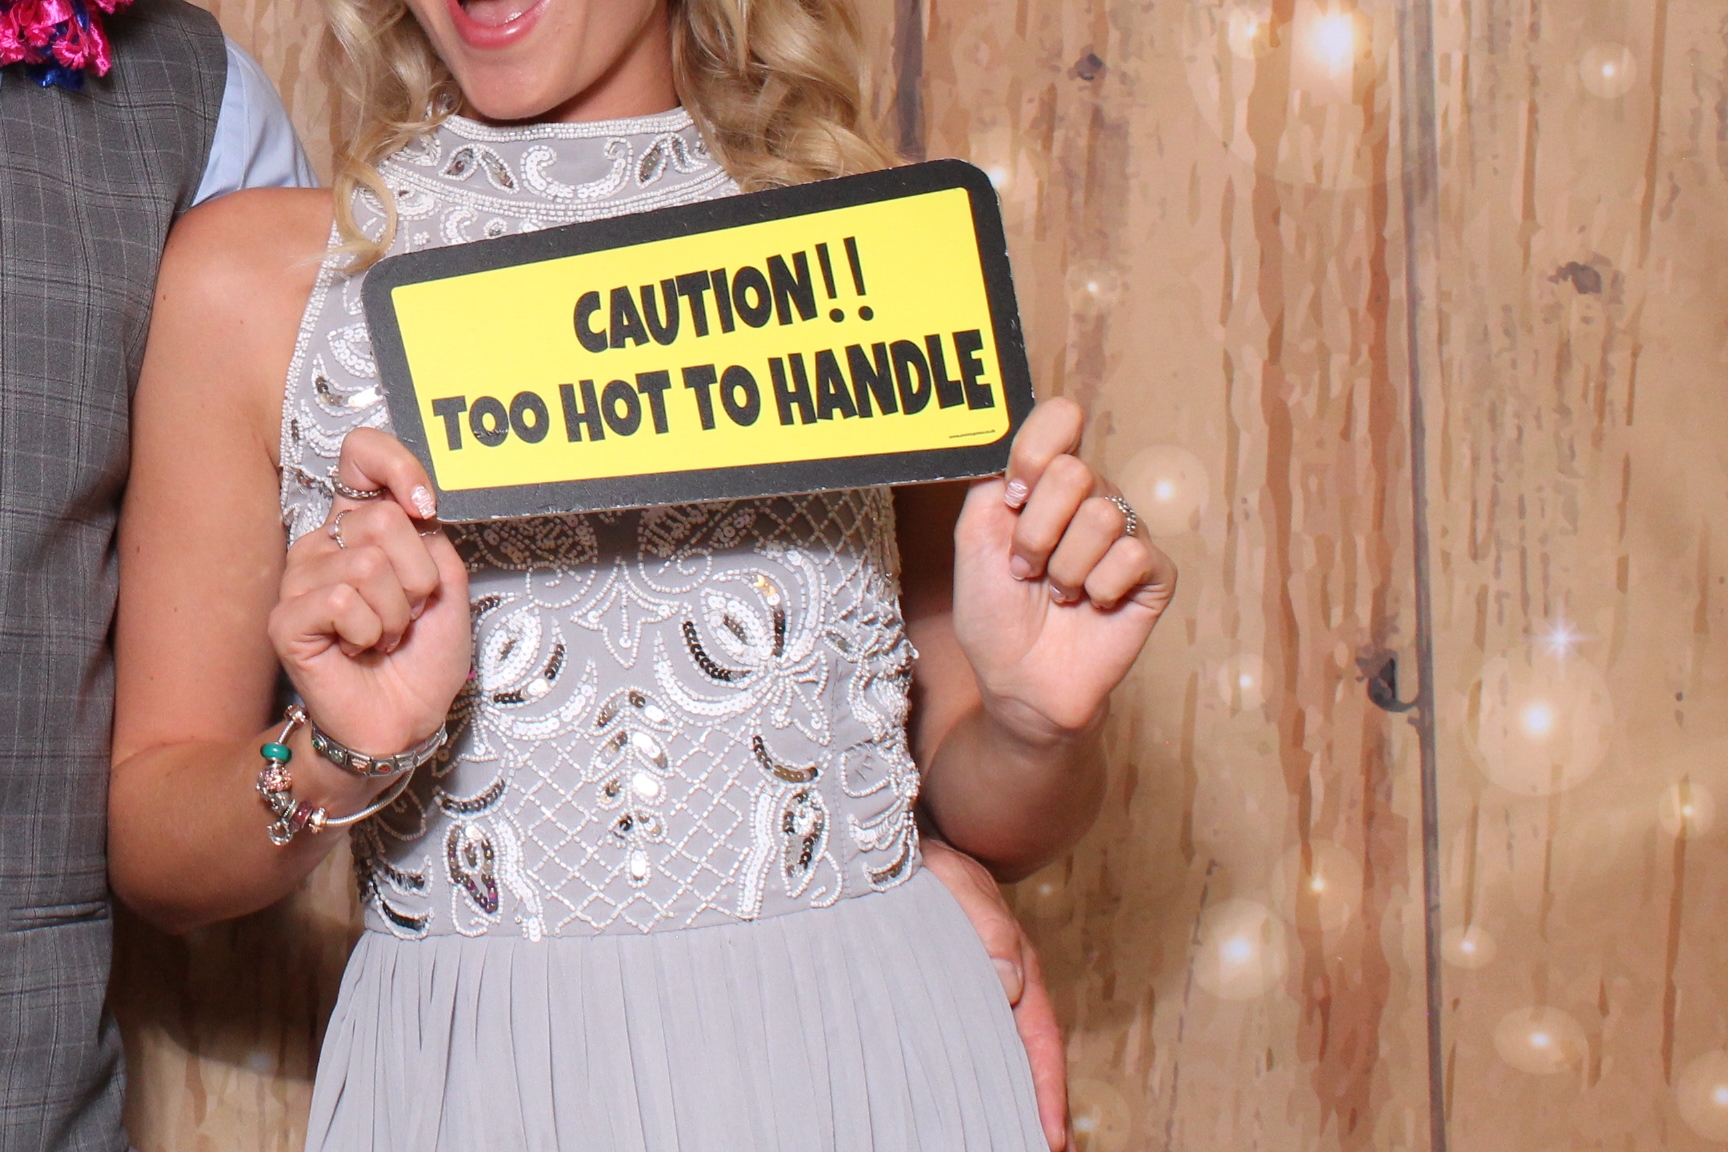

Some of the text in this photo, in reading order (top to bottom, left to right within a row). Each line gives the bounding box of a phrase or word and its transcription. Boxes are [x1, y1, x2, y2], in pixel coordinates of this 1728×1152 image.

[573, 236, 875, 353] CAUTION!!
[432, 329, 995, 451] TOO HOT TO HANDLE
